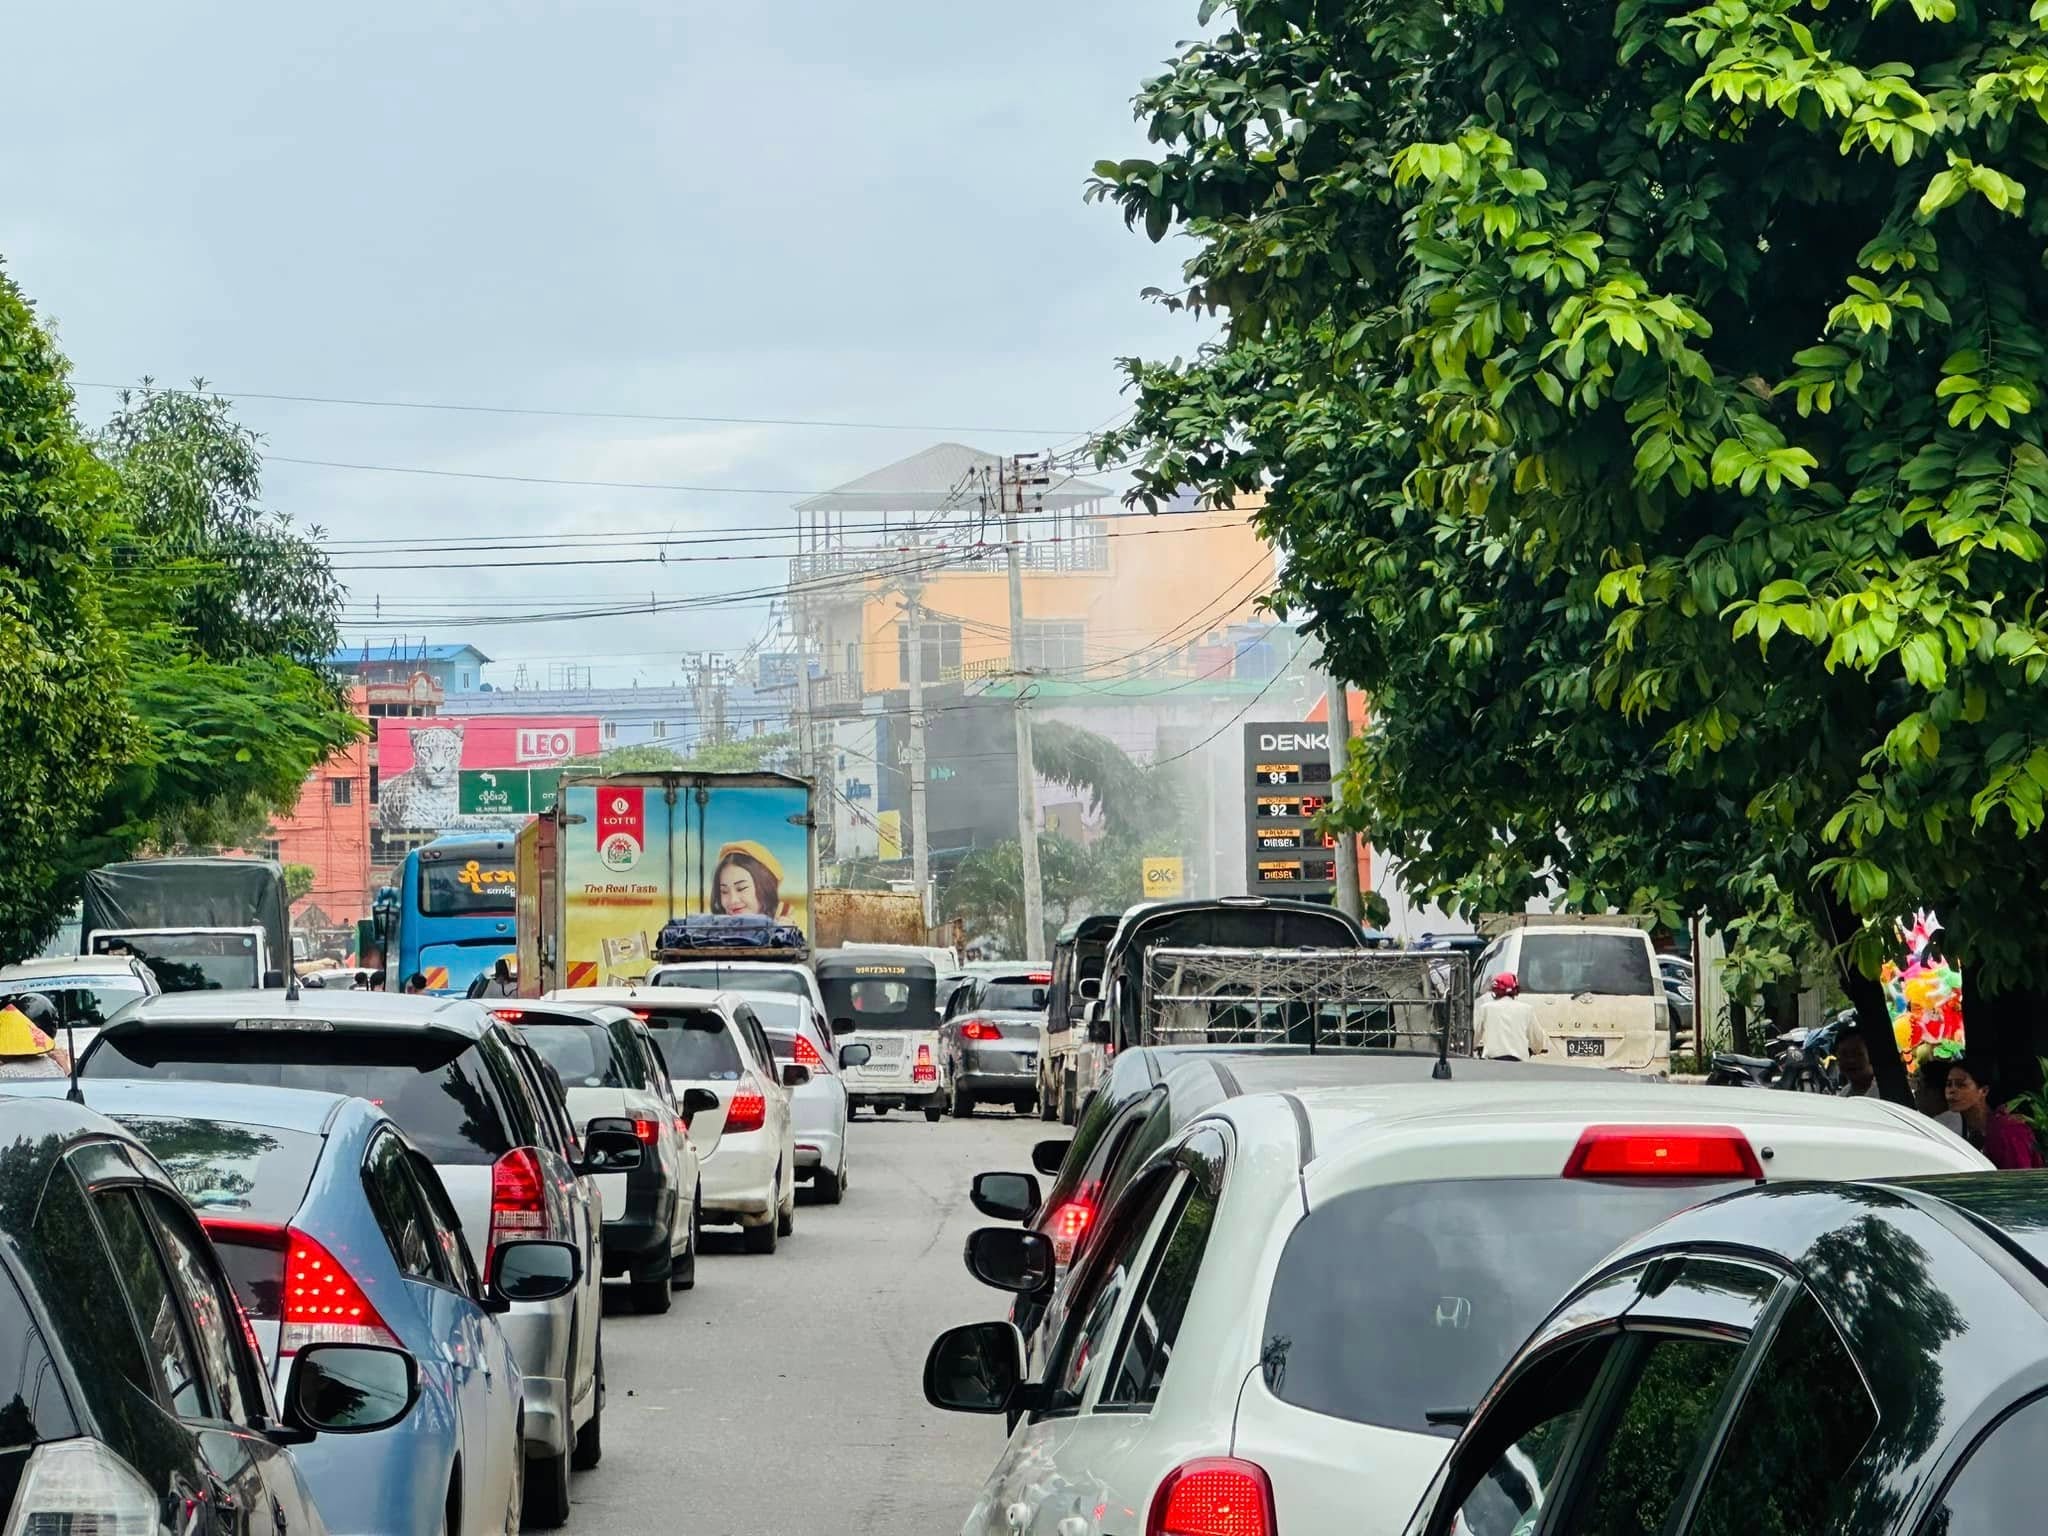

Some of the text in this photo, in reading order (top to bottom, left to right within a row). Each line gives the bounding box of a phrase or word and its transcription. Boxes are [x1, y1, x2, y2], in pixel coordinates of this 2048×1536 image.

[522, 733, 569, 755] LEO
[1269, 772, 1287, 784] 95
[1270, 804, 1287, 816] 92
[1263, 838, 1295, 848] DIESEL
[1264, 871, 1294, 880] DIESEL
[584, 884, 658, 894] The Real Taste
